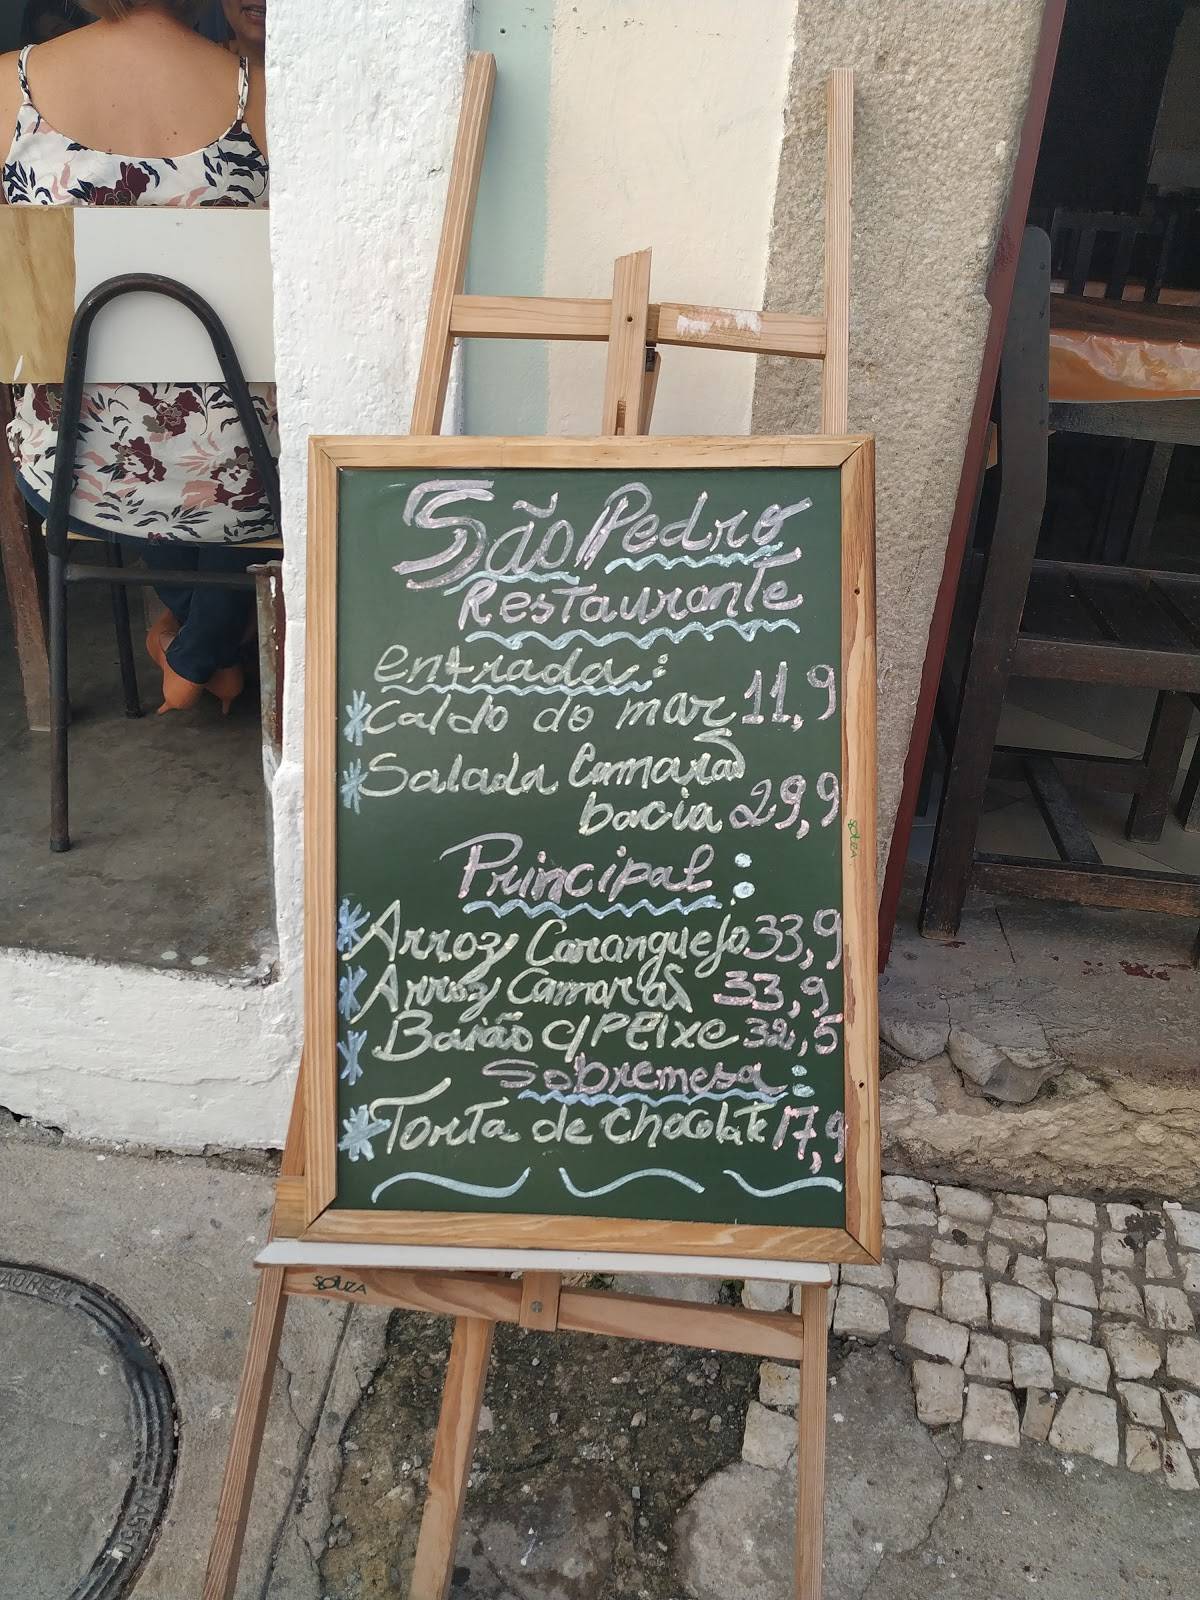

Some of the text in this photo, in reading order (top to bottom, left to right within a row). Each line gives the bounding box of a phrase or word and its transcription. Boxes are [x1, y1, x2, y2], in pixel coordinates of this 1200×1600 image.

[392, 479, 813, 591] São Pedro
[363, 694, 508, 735] Caldo
[533, 696, 594, 733] do
[741, 661, 837, 731] 11,9
[358, 752, 559, 797] Salada
[578, 772, 839, 840] bacia 29,9
[341, 899, 841, 991] Arroz Caranguejo 33,9
[350, 963, 502, 1023] Arroz
[713, 970, 829, 1019] 33,9
[369, 1077, 520, 1154] Torta
[532, 1103, 592, 1145] de
[772, 1105, 846, 1174] 17,9
